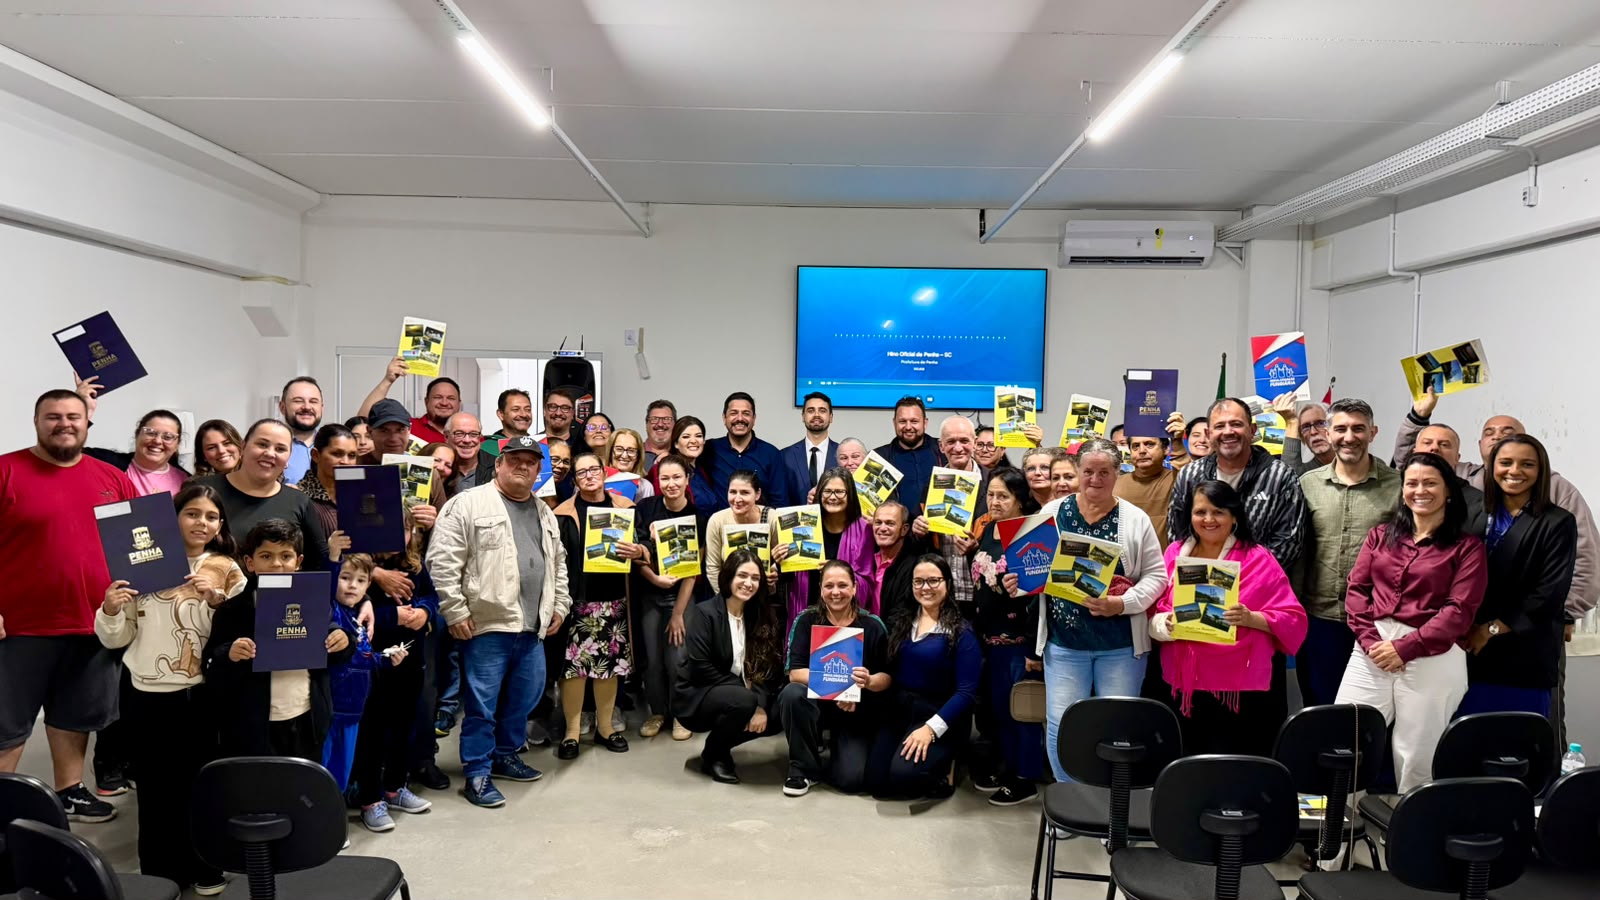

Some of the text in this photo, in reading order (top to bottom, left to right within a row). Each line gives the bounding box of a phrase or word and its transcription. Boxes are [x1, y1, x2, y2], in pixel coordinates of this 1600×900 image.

[91, 353, 118, 368] PENHA
[128, 546, 164, 560] PENHA
[276, 626, 307, 635] PENHA
